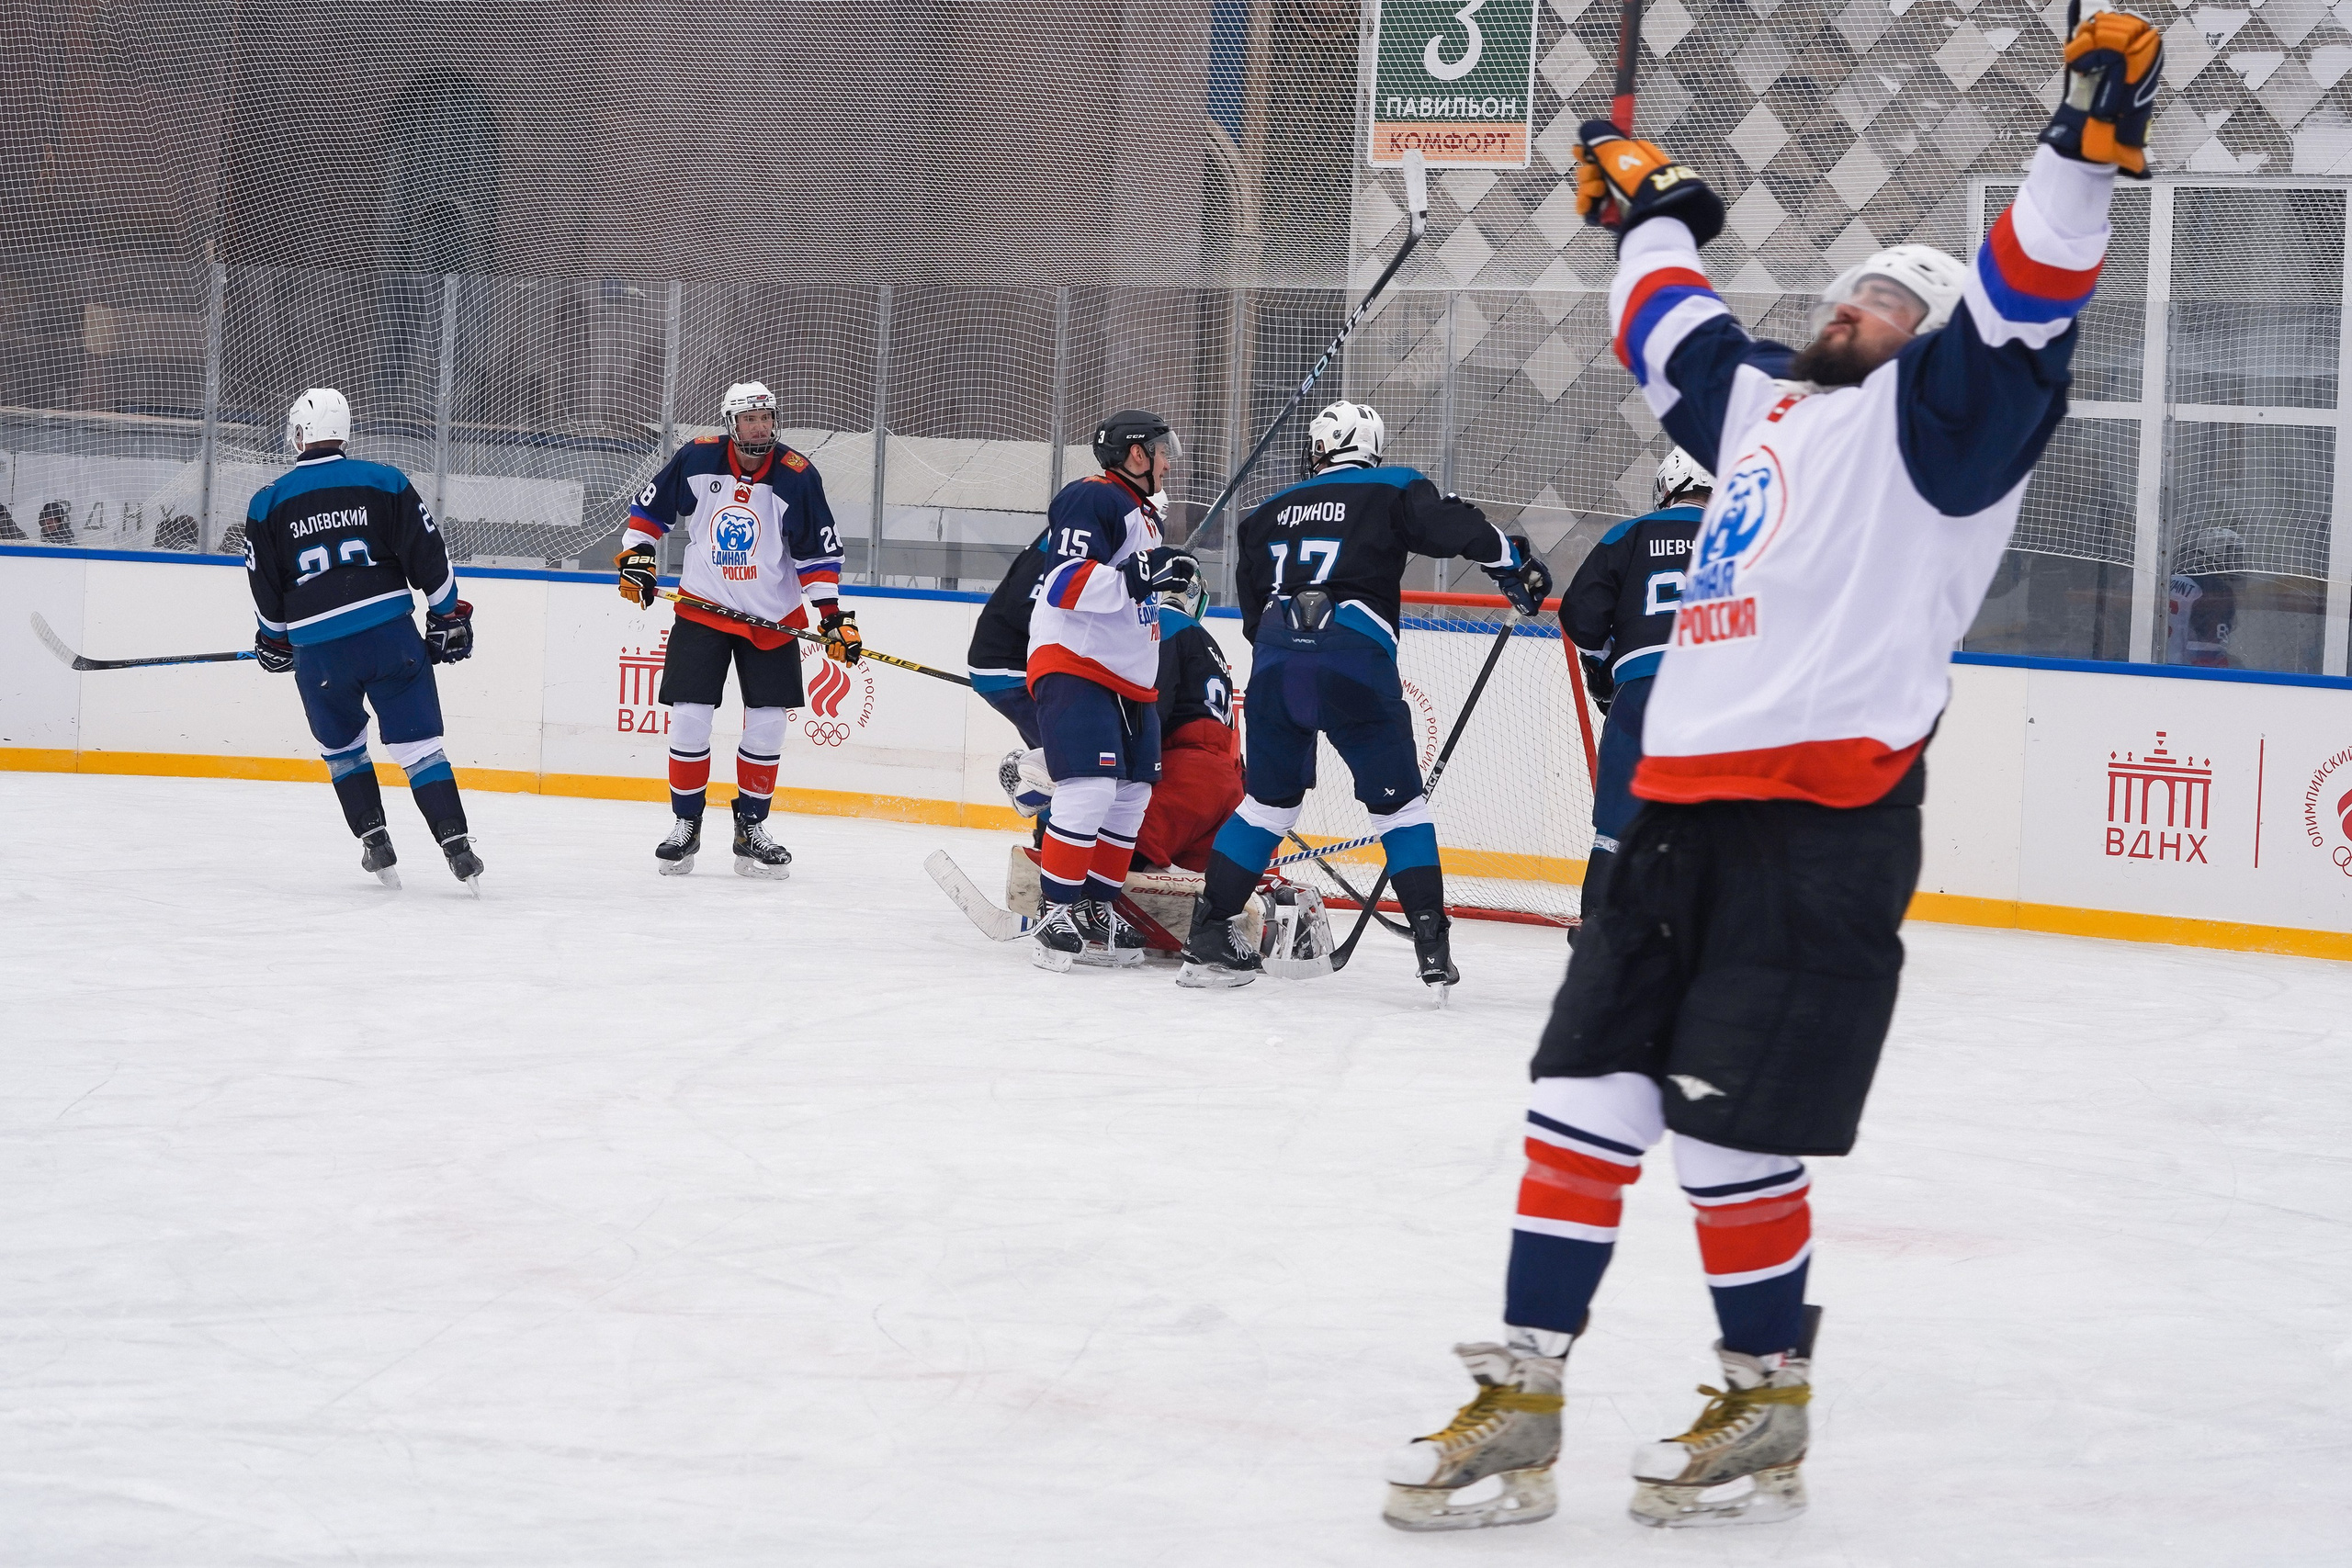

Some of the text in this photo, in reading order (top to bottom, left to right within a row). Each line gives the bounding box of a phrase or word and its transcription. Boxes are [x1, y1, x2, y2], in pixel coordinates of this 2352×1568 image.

[1423, 0, 1486, 80] 3
[1385, 96, 1517, 118] ПАВИЛЬОН
[1389, 131, 1510, 154] КОМФОРТ
[1098, 430, 1106, 444] 3
[639, 482, 657, 506] 8
[289, 506, 368, 539] ЗАЛЕВСКИЙ
[418, 502, 438, 534] 2
[244, 536, 256, 571] 3
[712, 550, 748, 567] ЕДИНАЯ
[1057, 526, 1091, 558] 15
[722, 565, 758, 581] РОССИЯ
[1268, 537, 1342, 594] 17
[701, 604, 813, 639] CATALYST
[1679, 597, 1756, 647] РОССИЯ
[864, 649, 918, 671] RUE
[857, 678, 875, 728] РОССИИ
[1402, 679, 1438, 772] МИТЕТ РОССИИ
[1422, 770, 1441, 803] LACK
[2105, 827, 2209, 864] ВДНХ
